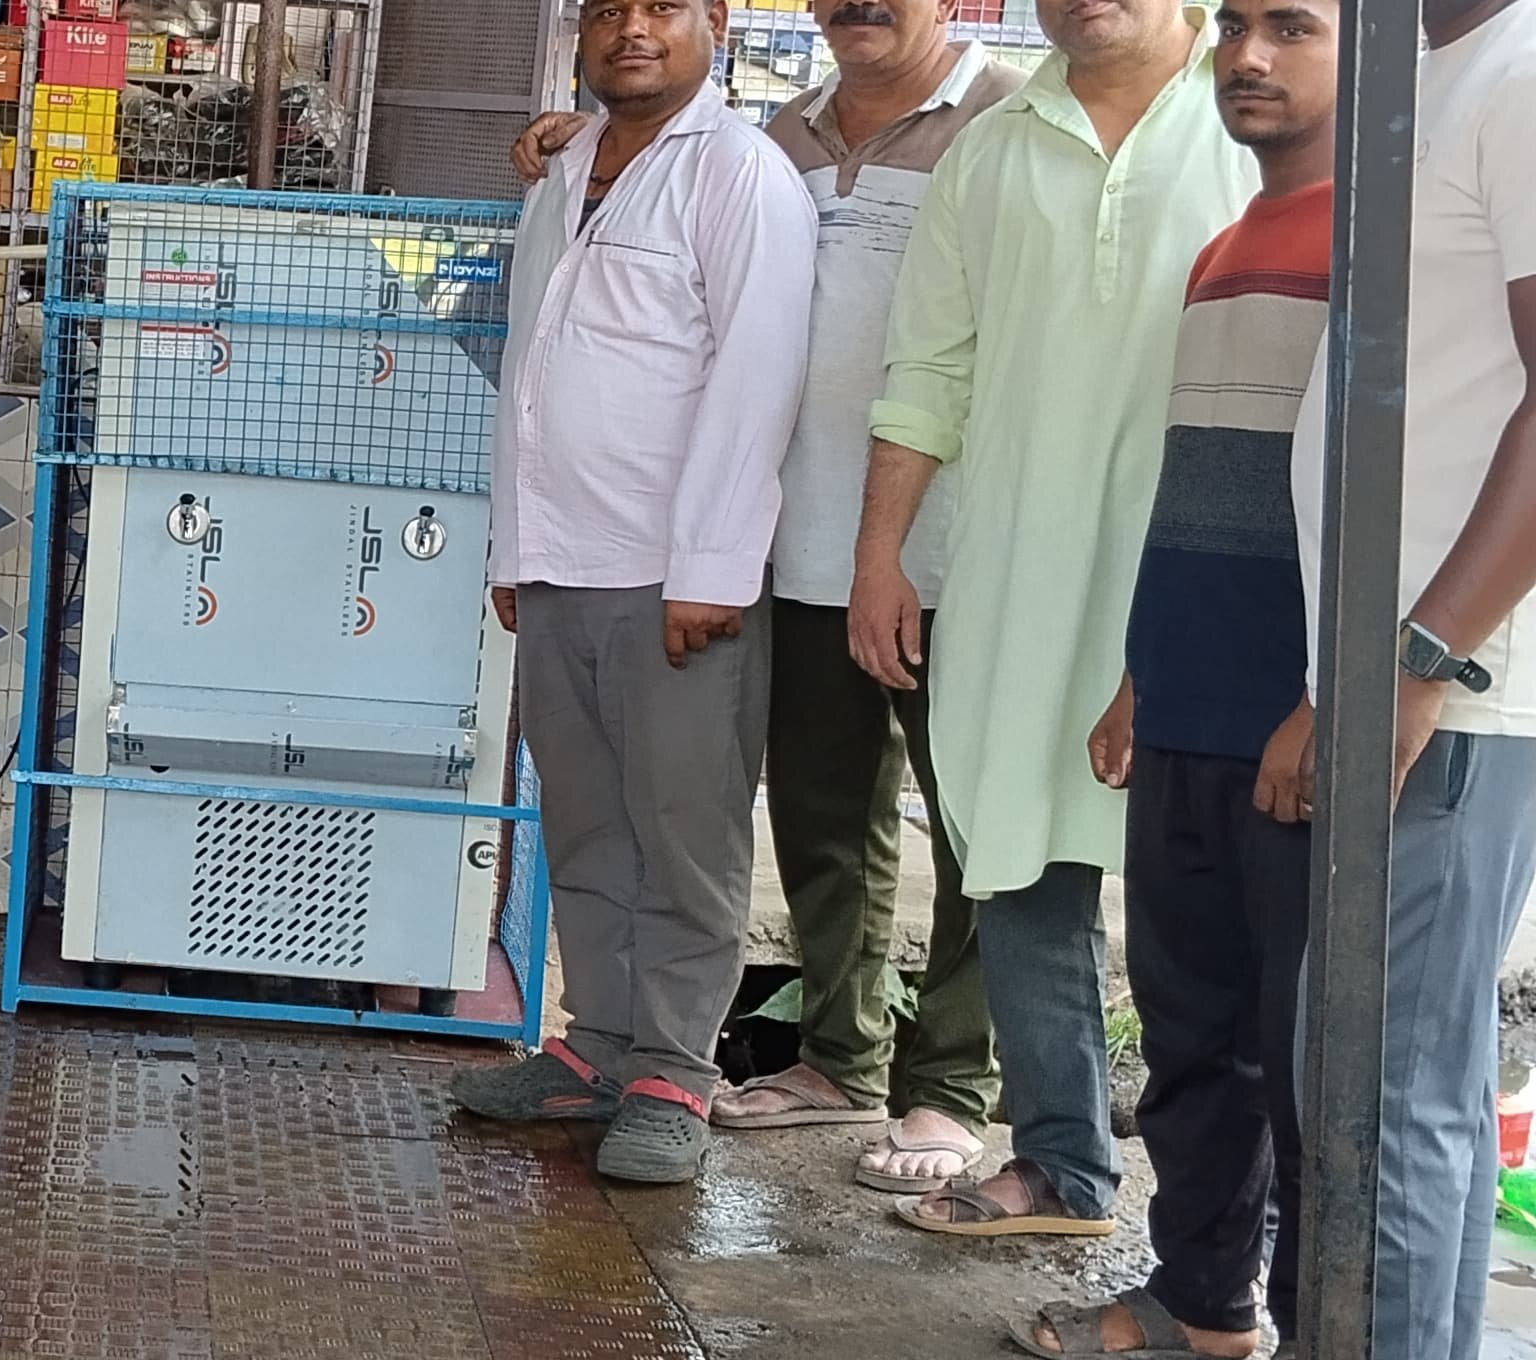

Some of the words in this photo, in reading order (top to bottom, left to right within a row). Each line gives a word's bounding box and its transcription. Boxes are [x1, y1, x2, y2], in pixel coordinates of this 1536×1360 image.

[66, 25, 107, 46] Kite
[145, 272, 212, 284] INSTRUCTIONS
[346, 504, 357, 552] JINDAL
[358, 505, 383, 593] JSL
[182, 553, 194, 627] STAINLESS
[341, 563, 353, 637] STAINLESS
[284, 733, 305, 773] JSL
